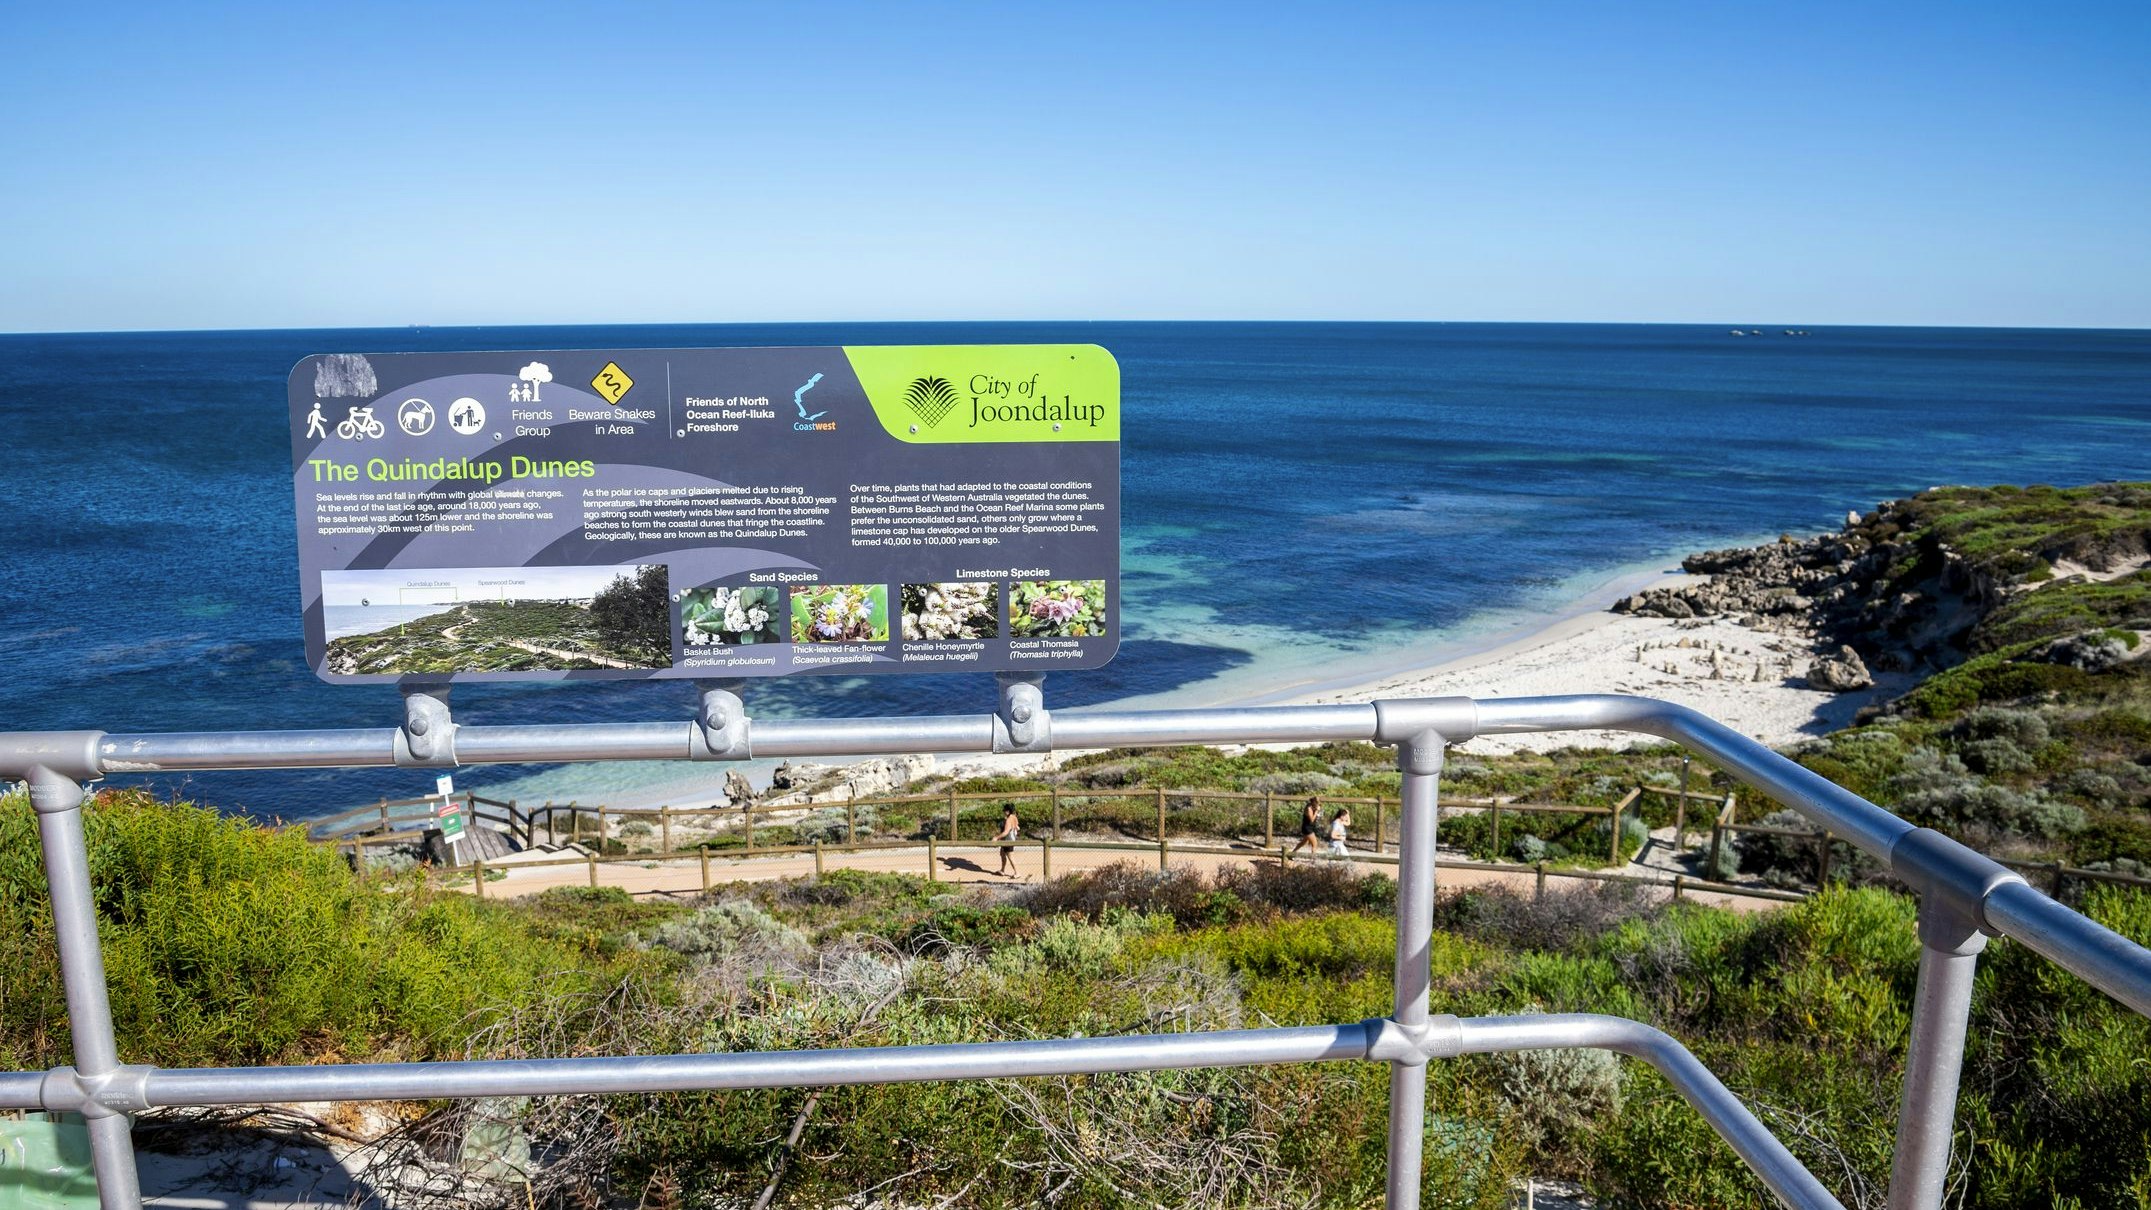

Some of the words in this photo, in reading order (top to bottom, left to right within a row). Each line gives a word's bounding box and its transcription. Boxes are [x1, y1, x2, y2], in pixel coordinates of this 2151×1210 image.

[969, 374, 1011, 398] City
[1018, 373, 1039, 398] of
[686, 396, 724, 406] Friends
[726, 396, 737, 406] of
[739, 396, 769, 405] North
[512, 408, 553, 420] Friends
[569, 408, 611, 419] Beware
[614, 407, 656, 419] Snakes
[686, 409, 720, 419] Ocean
[722, 408, 775, 419] Reef-Iluka
[969, 395, 1105, 427] Joondalup
[515, 424, 551, 439] Group
[595, 424, 605, 435] in
[607, 423, 635, 434] Area
[687, 421, 739, 432] Foreshore
[793, 421, 836, 431] Coastwest
[308, 457, 359, 480] The
[365, 456, 503, 485] Quindalup
[510, 455, 595, 478] Dunes
[582, 488, 594, 496] As
[595, 487, 609, 496] the
[611, 487, 632, 497] polar
[634, 487, 646, 495] ice
[648, 488, 669, 497] caps
[670, 486, 686, 495] and
[688, 486, 722, 496] glaciers
[721, 485, 751, 494] melted
[752, 485, 769, 494] due
[770, 485, 779, 493] to
[781, 485, 804, 495] rising
[850, 483, 870, 492] Over
[871, 483, 892, 493] time,
[894, 482, 920, 493] plants
[921, 482, 938, 491] that
[939, 482, 955, 491] had
[957, 481, 991, 492] adapted
[993, 482, 1002, 490] to
[1003, 481, 1017, 490] the
[1018, 481, 1048, 490] coastal
[1049, 480, 1092, 489] conditions
[583, 498, 639, 508] temperatures,
[638, 497, 654, 506] the
[653, 497, 691, 506] shoreline
[690, 497, 719, 505] moved
[720, 496, 763, 505] eastwards.
[764, 496, 790, 504] About
[790, 496, 814, 505] 8,000
[814, 497, 837, 506] years
[850, 494, 859, 502] of
[860, 493, 874, 502] the
[876, 493, 920, 502] Southwest
[921, 493, 930, 502] of
[931, 492, 966, 501] Western
[967, 492, 1003, 501] Australia
[1004, 492, 1045, 502] vegetated
[1046, 491, 1060, 500] the
[1061, 491, 1089, 500] dunes.
[316, 503, 326, 511] At
[327, 503, 341, 511] the
[343, 503, 359, 511] end
[360, 502, 369, 511] of
[371, 502, 385, 511] the
[386, 502, 402, 510] last
[402, 502, 416, 510] ice
[417, 503, 435, 512] age,
[437, 501, 466, 510] around
[468, 501, 496, 510] 18,000
[498, 502, 521, 511] years
[522, 502, 541, 510] ago,
[851, 504, 887, 513] Between
[889, 504, 913, 513] Burns
[915, 504, 941, 513] Beach
[943, 503, 959, 512] and
[960, 503, 974, 512] the
[975, 503, 1003, 512] Ocean
[1005, 503, 1024, 511] Reef
[1025, 502, 1054, 511] Marina
[1079, 501, 1104, 512] plants
[317, 514, 331, 522] the
[349, 513, 368, 522] level
[388, 512, 413, 521] about
[414, 512, 439, 521] 125m
[438, 512, 462, 521] lower
[464, 512, 480, 520] and
[481, 511, 495, 520] the
[497, 511, 535, 520] shoreline
[851, 515, 875, 526] prefer
[876, 515, 891, 524] the
[892, 514, 955, 524] unconsolidated
[956, 514, 979, 524] sand,
[981, 513, 1007, 522] others
[1008, 513, 1027, 524] only
[1027, 515, 1049, 524] grow
[1050, 513, 1075, 521] where
[318, 524, 376, 535] approximately
[377, 524, 401, 532] 30km
[402, 524, 423, 532] west
[422, 523, 433, 532] of
[434, 523, 450, 532] this
[451, 523, 475, 533] point.
[584, 530, 637, 541] Geologically,
[638, 530, 662, 538] these
[678, 529, 706, 538] known
[719, 529, 734, 537] the
[734, 528, 778, 539] Quindalup
[779, 528, 808, 537] Dunes.
[851, 526, 891, 535] limestone
[892, 527, 909, 536] cap
[910, 525, 925, 534] has
[927, 525, 970, 535] developed
[984, 524, 998, 533] the
[999, 524, 1020, 533] older
[1021, 523, 1068, 534] Spearwood
[1070, 523, 1098, 533] Dunes,
[851, 536, 881, 545] formed
[882, 536, 911, 546] 40,000
[912, 536, 922, 545] to
[924, 535, 956, 546] 100,000
[958, 537, 980, 546] years
[982, 537, 1000, 546] ago.
[749, 572, 776, 582] Sand
[777, 571, 818, 583] Species
[956, 567, 1008, 577] Limestone
[1010, 567, 1050, 579] Species
[792, 644, 843, 653] Thick-leaved
[844, 643, 886, 652] Fan-flower
[902, 642, 934, 650] Chenille
[935, 641, 985, 652] Honeymyrtle
[1009, 639, 1039, 648] Coastal
[1042, 639, 1079, 648] Thomasia
[683, 647, 712, 655] Basket
[711, 647, 734, 655] Bush
[902, 652, 944, 662] (Melaleuca
[945, 651, 978, 662] huegelii)
[1009, 649, 1050, 660] (Thomasia
[1051, 649, 1083, 659] triphylla)
[683, 657, 726, 667] (Spyridium
[727, 656, 775, 667] globulosum)
[792, 654, 830, 665] (Scaevola
[831, 654, 873, 664] crassifolia)
